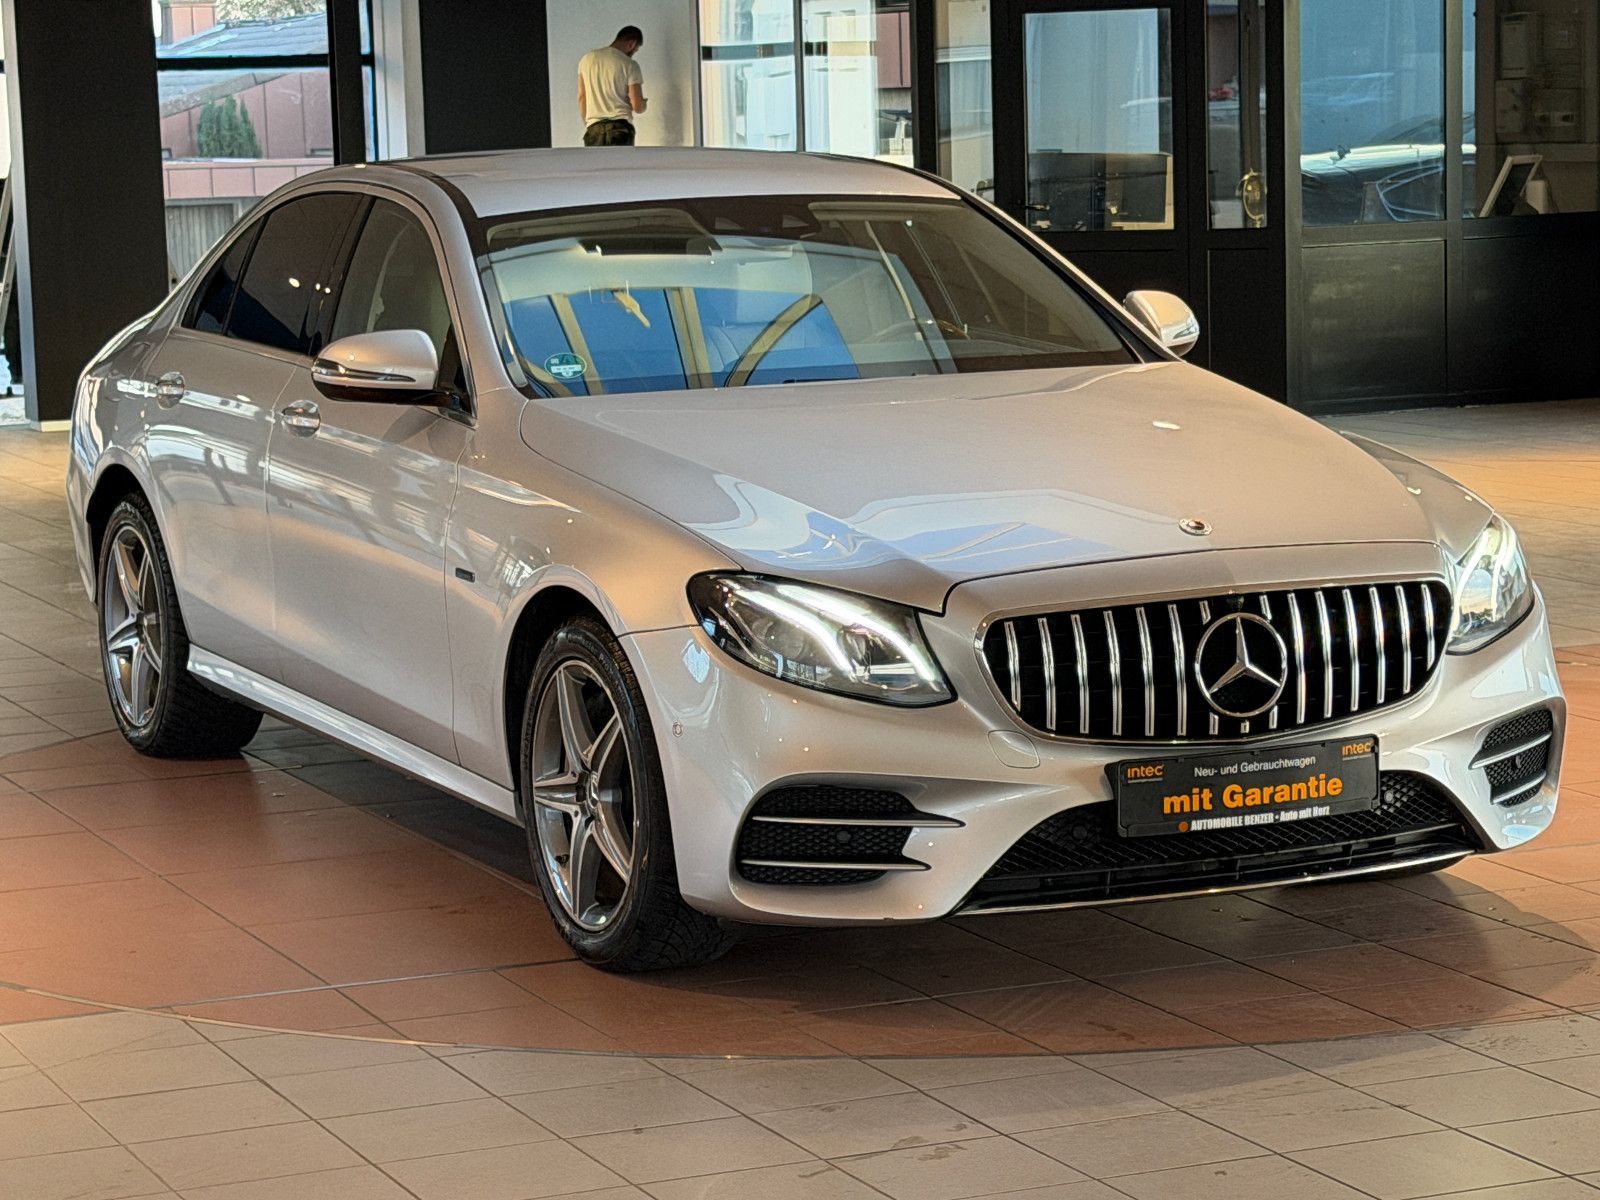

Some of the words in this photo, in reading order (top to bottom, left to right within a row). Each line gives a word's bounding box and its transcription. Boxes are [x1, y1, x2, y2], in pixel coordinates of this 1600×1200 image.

[1342, 741, 1373, 756] intec
[1127, 764, 1164, 779] intec
[1194, 766, 1218, 778] Neu-
[1220, 763, 1238, 775] und
[1240, 756, 1316, 773] Gebrauchtwagen
[1163, 787, 1213, 814] mit
[1222, 773, 1343, 809] Garantie
[1190, 815, 1243, 831] AUTOMOBILE
[1280, 810, 1298, 822] Auto
[1299, 808, 1311, 819] mit
[1312, 805, 1330, 817] Herz
